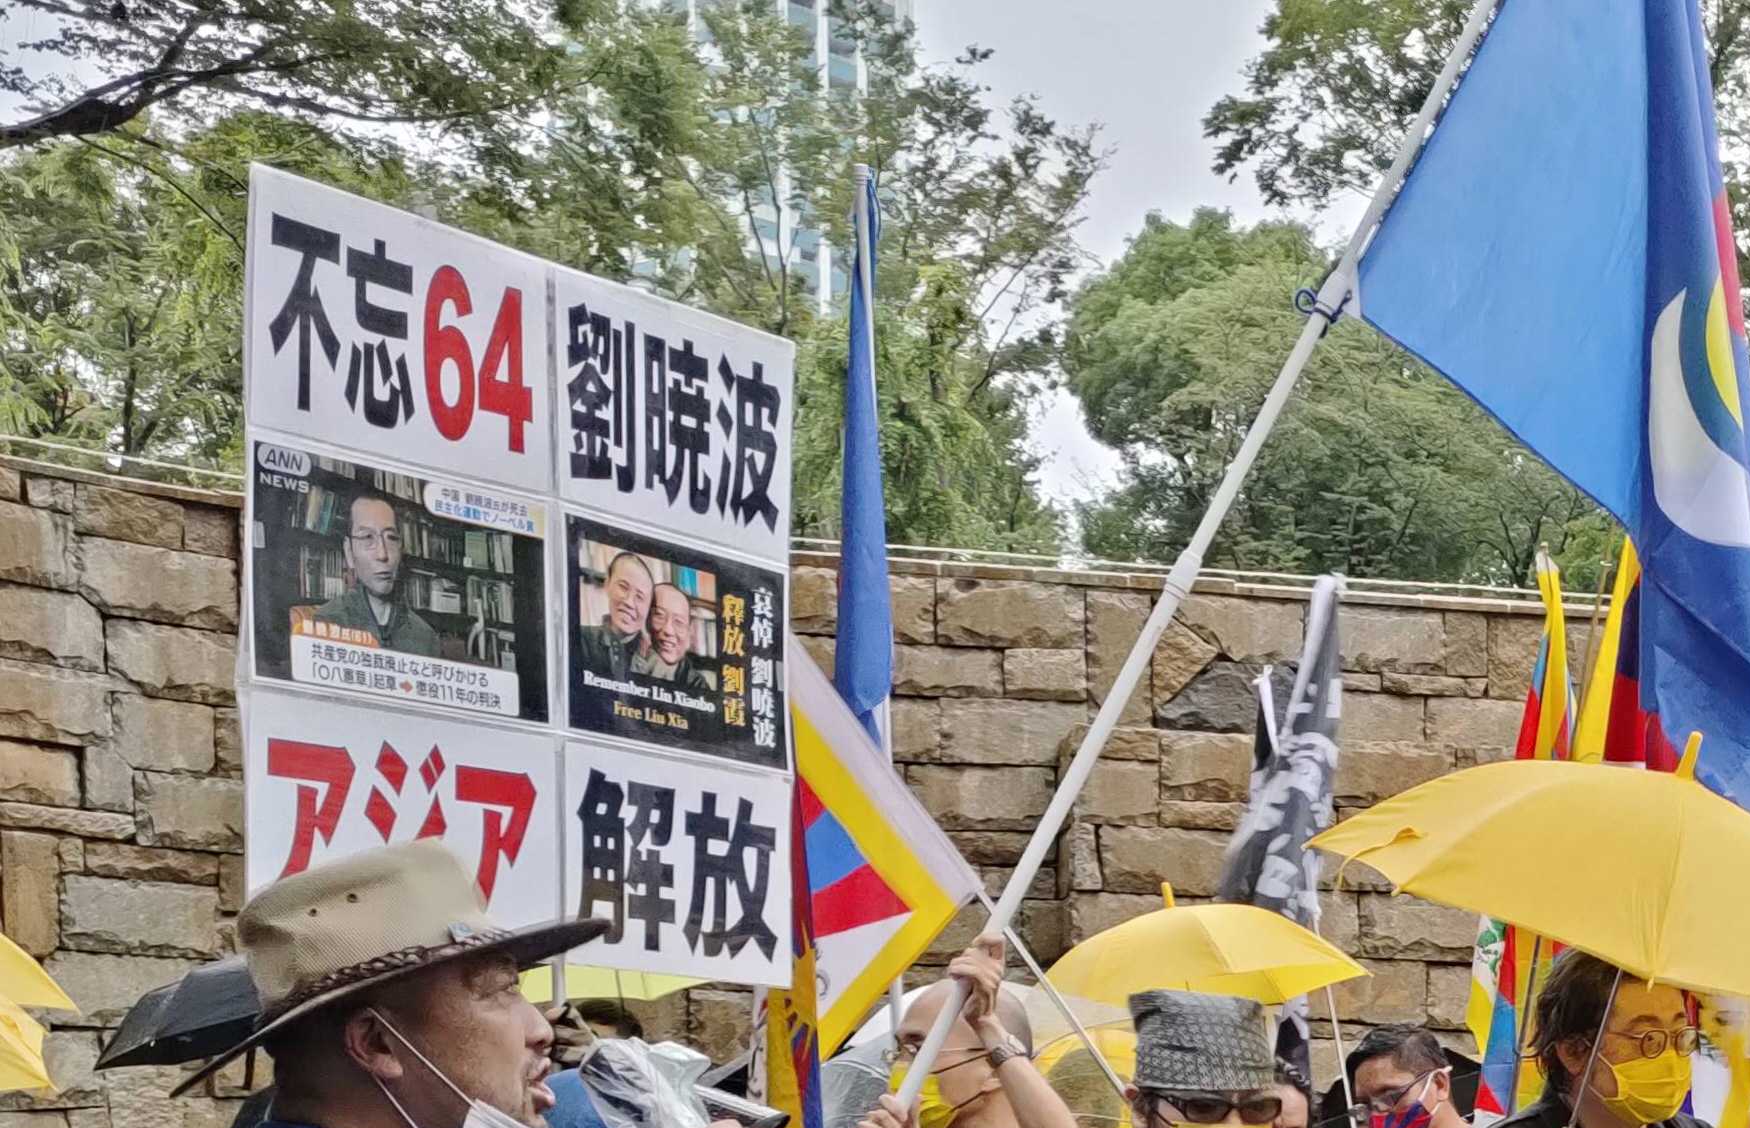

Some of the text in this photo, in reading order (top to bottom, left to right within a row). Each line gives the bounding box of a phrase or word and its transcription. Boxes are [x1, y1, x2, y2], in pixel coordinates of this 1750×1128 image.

[268, 211, 534, 455] 不忘64
[263, 448, 304, 472] ANN
[260, 470, 310, 493] NEWS
[582, 669, 651, 699] Remember
[651, 685, 673, 704] Liu
[613, 700, 690, 731] Free Liu Xia
[576, 766, 779, 963] 解放
